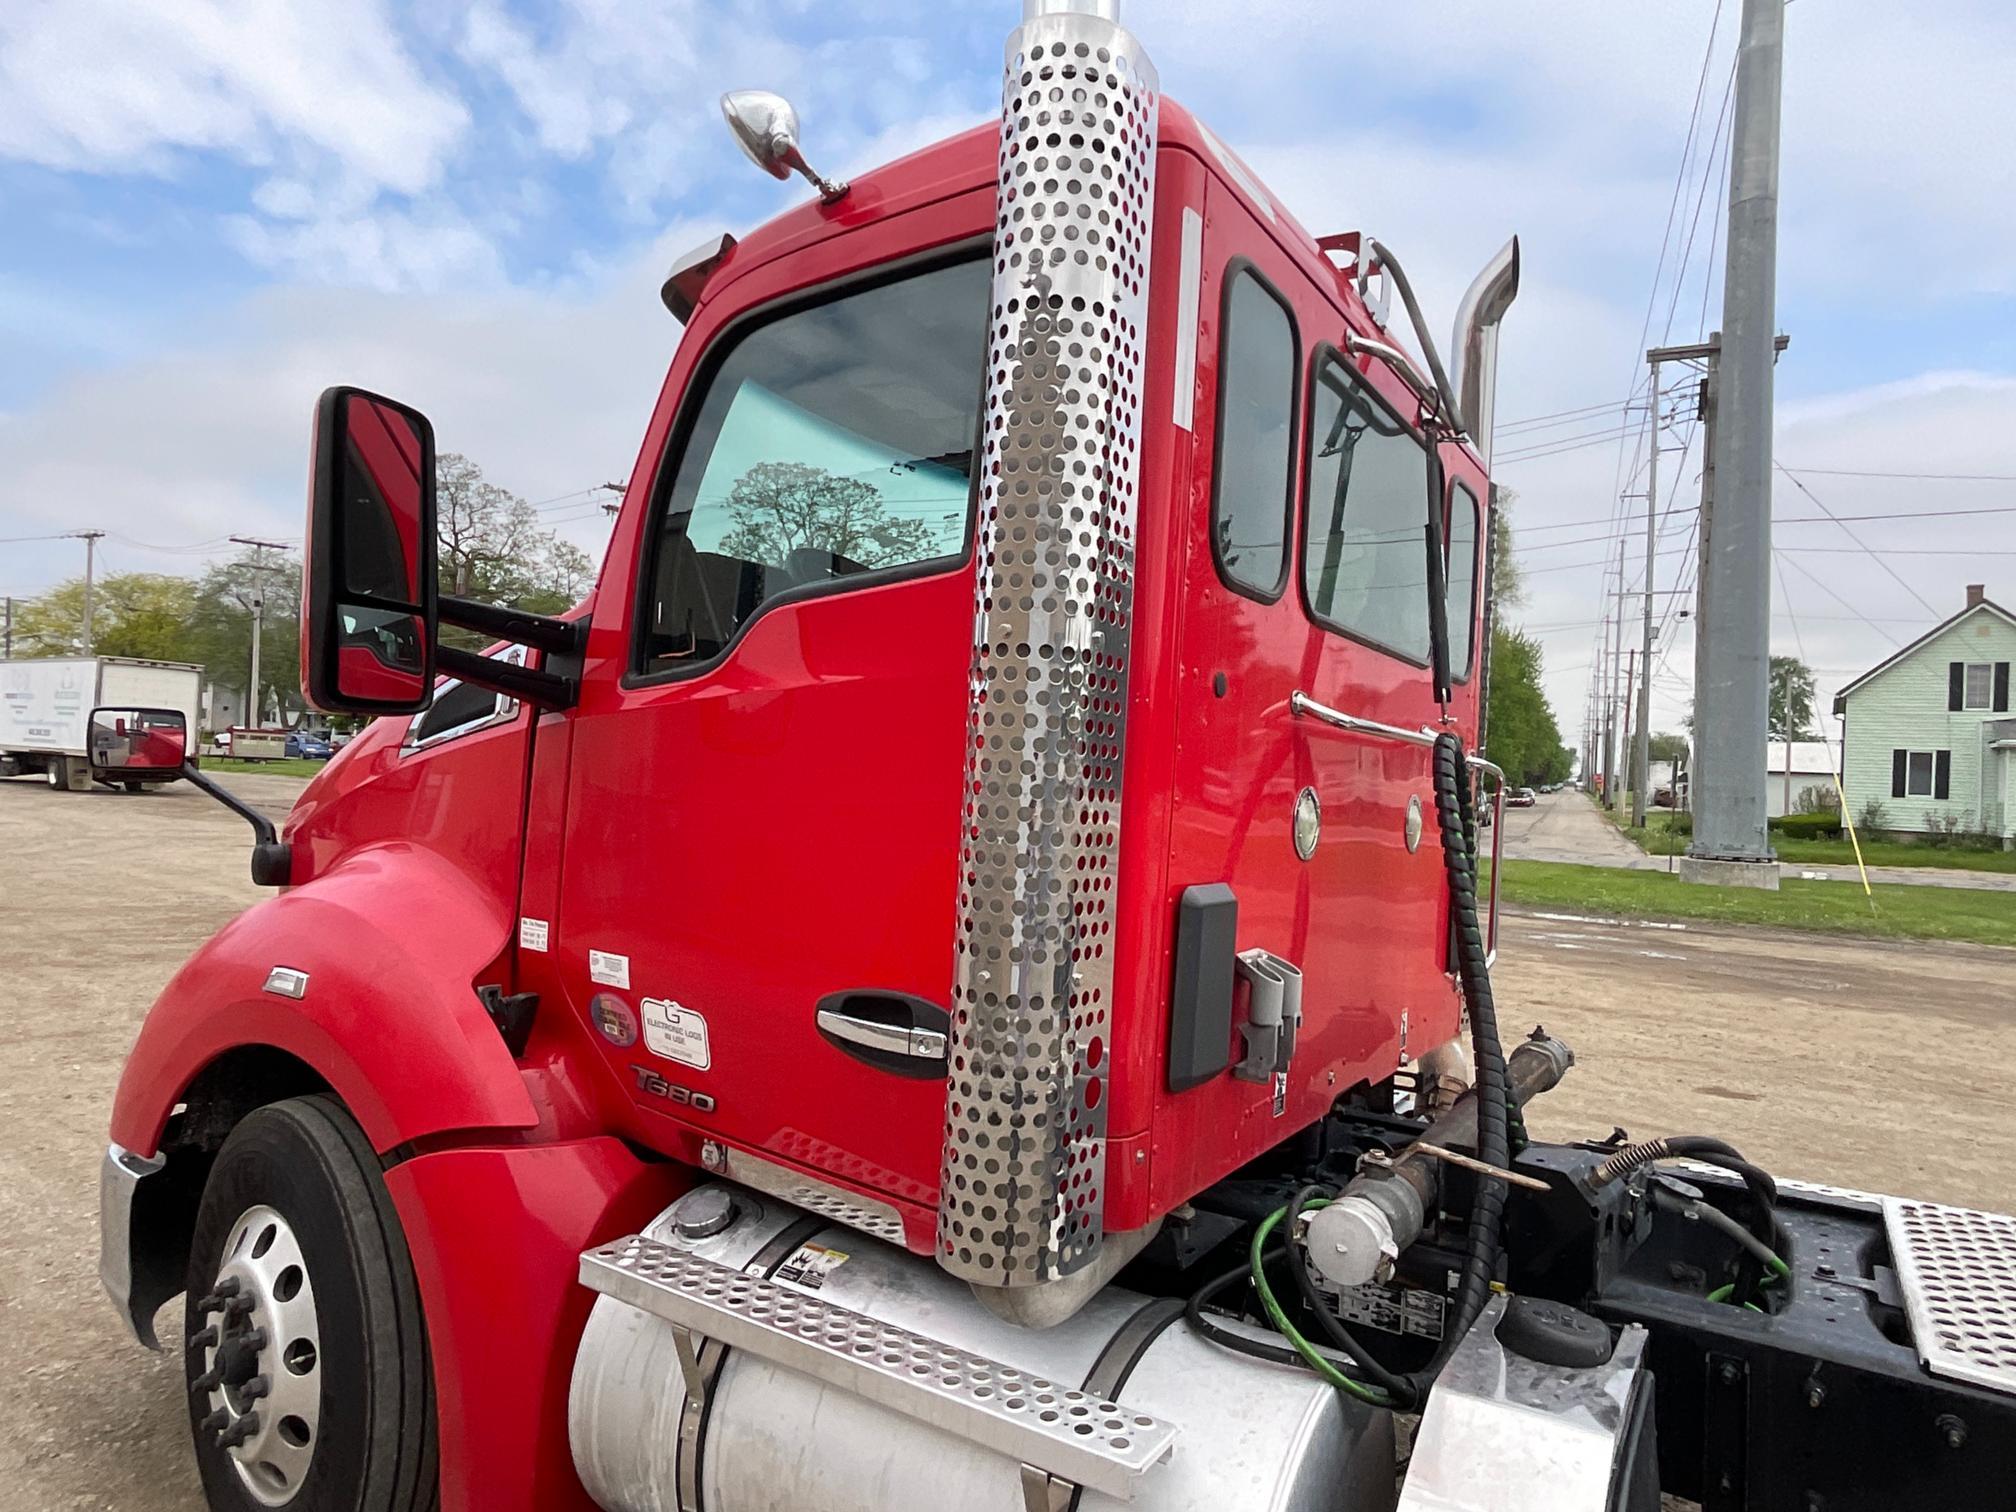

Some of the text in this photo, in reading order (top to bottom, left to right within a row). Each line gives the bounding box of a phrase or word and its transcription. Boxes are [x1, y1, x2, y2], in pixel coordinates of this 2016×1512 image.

[646, 1017, 684, 1036] ELECTRONIC
[684, 1029, 703, 1041] LOGS
[672, 1034, 686, 1046] USE
[630, 1064, 715, 1112] T680
